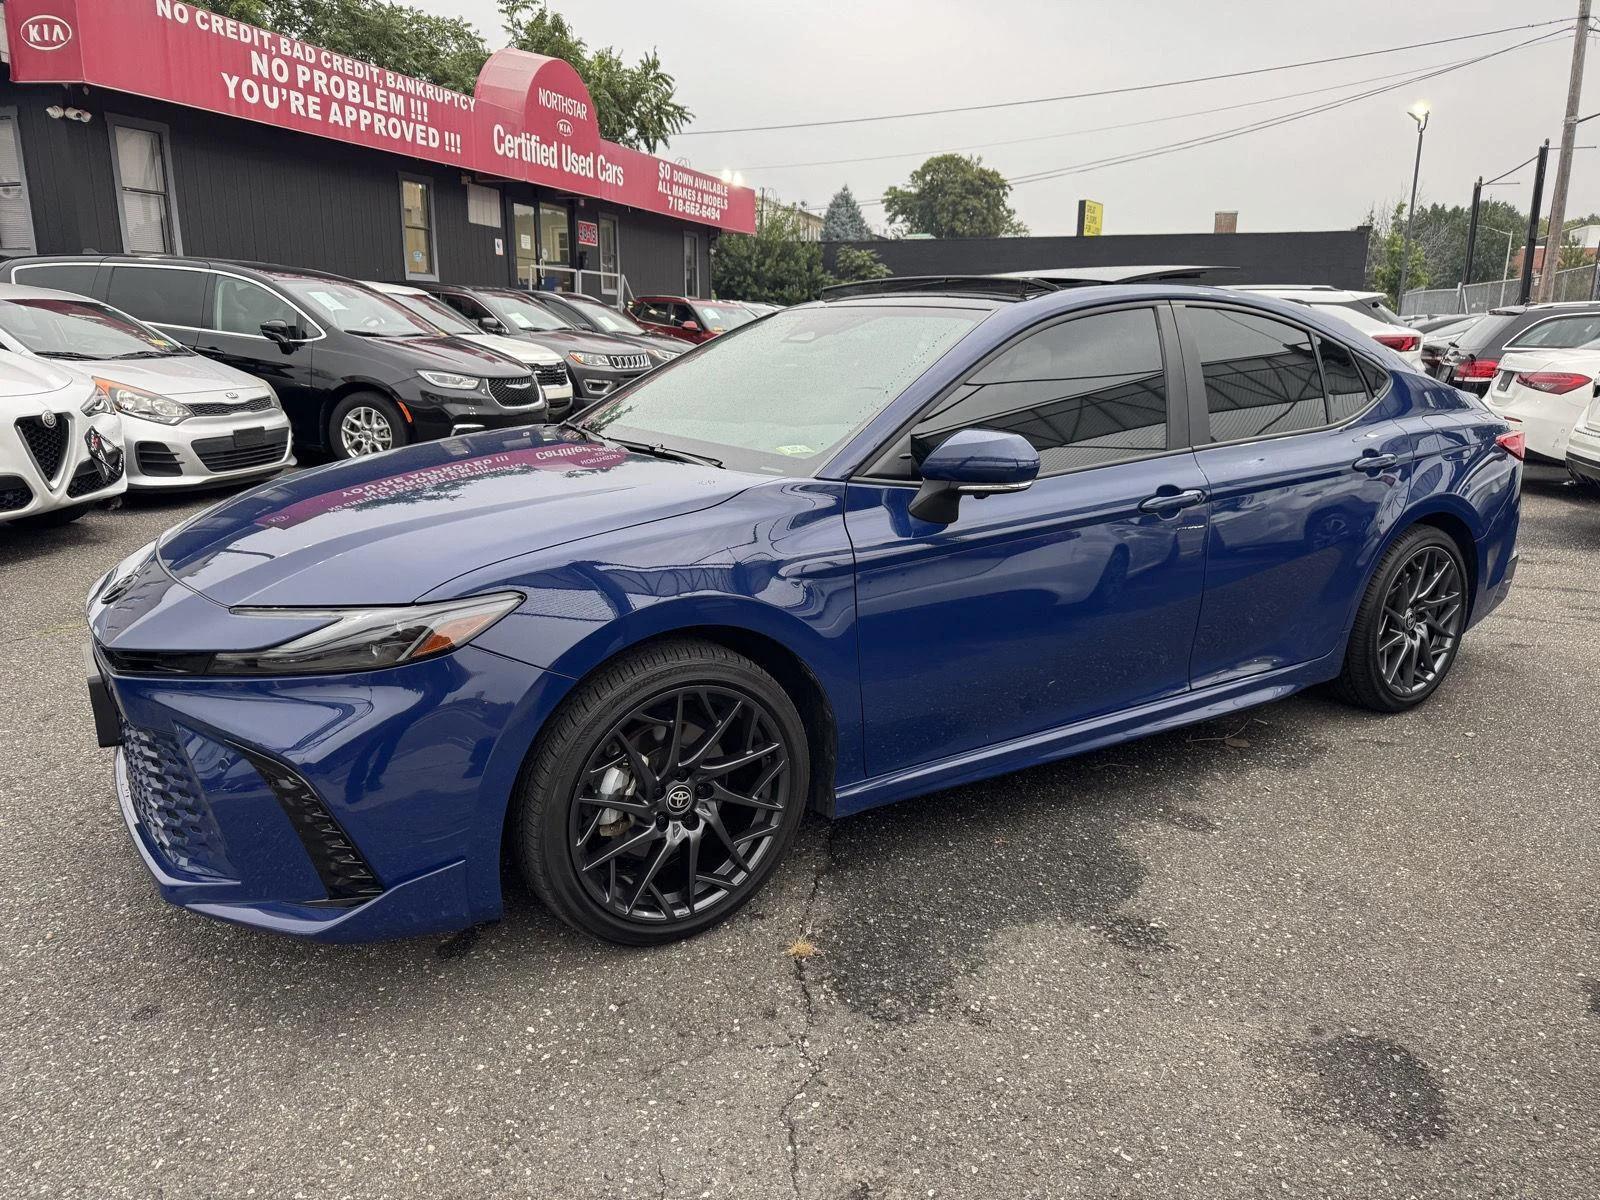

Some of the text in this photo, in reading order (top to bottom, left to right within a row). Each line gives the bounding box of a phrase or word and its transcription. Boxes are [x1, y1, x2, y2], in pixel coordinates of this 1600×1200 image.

[28, 23, 66, 42] KIA
[156, 0, 476, 112] NO CREDIT, BAD CREDIT, BANKRUPTCY
[251, 50, 428, 123] NO PROBLEM !!!
[538, 87, 588, 120] NORTHSTAR
[221, 72, 462, 154] YOU'RE APPROVED !!!
[559, 122, 572, 134] KIA
[493, 123, 624, 186] Certified Used Cars
[657, 180, 728, 210] ALL MAKES & MODELS
[658, 161, 728, 197] $0 DOWN AVAILABLE
